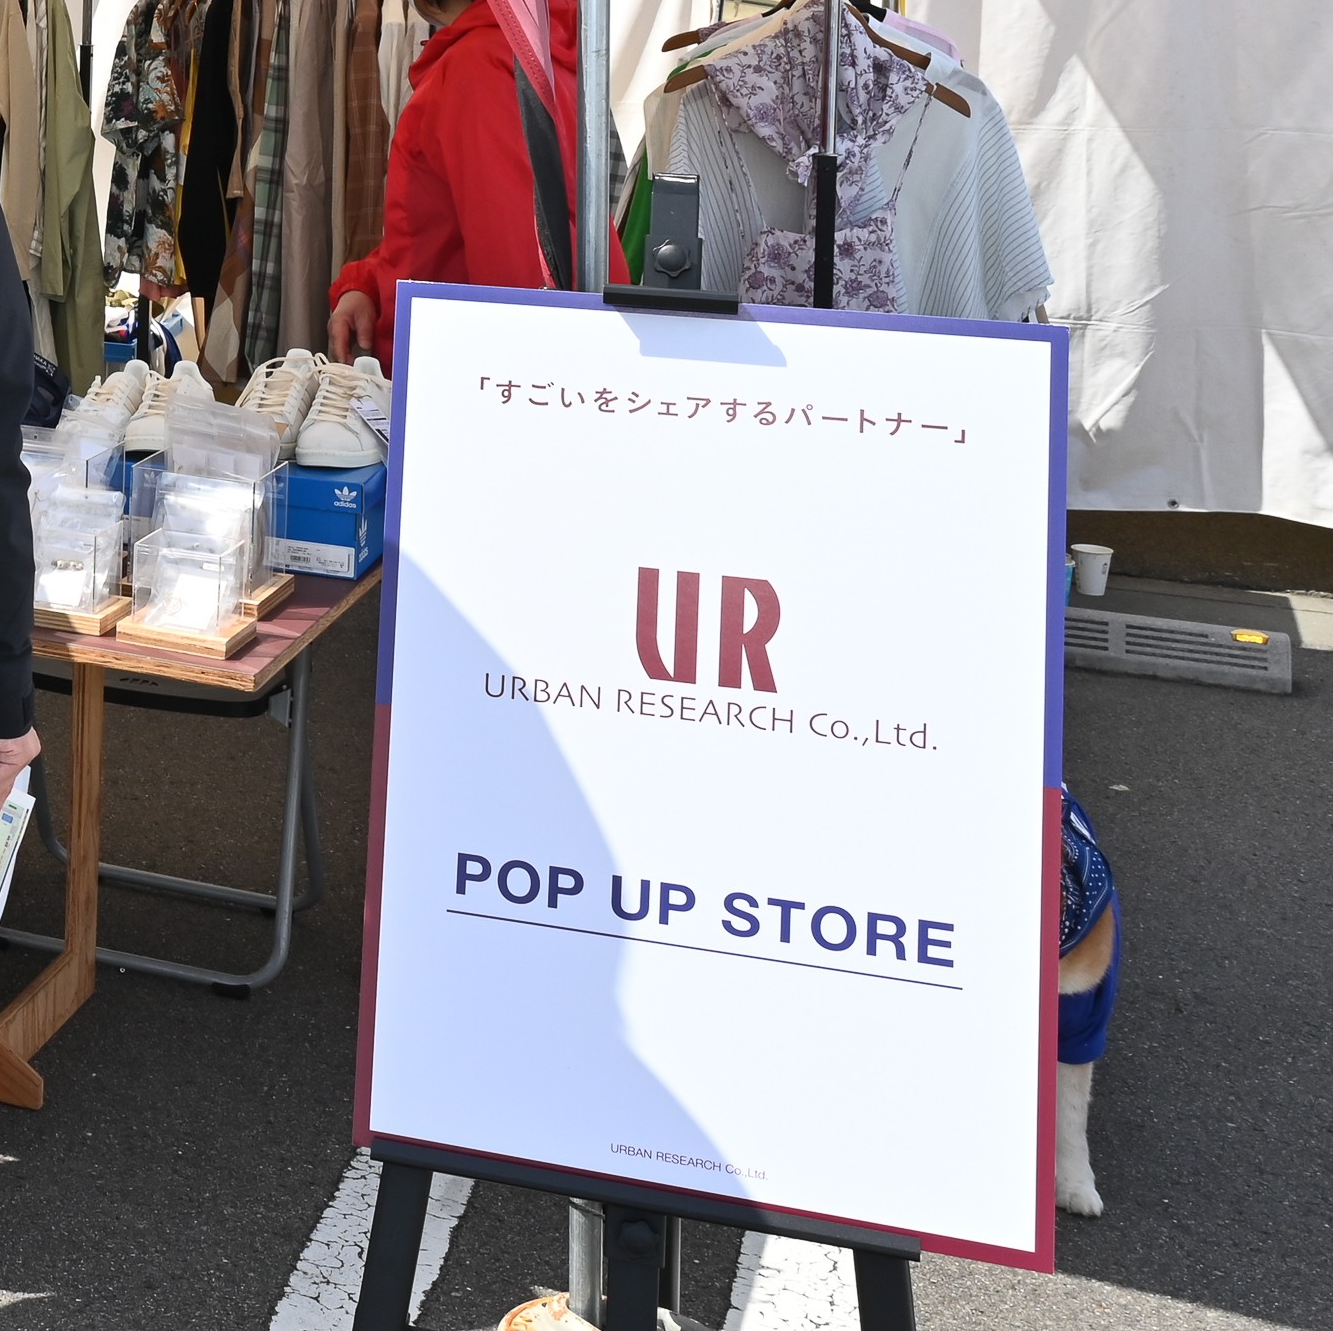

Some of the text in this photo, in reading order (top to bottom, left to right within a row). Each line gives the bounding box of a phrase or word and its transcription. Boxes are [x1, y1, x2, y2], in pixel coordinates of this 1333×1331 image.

[479, 375, 968, 445] 「すごいをシェアするパートナー」
[333, 501, 357, 509] adidas
[635, 566, 781, 694] UR
[484, 672, 940, 751] URBAN RESEARCH Co.,Ltd.
[455, 851, 956, 969] POP UP STORE
[610, 1142, 653, 1160] URBAN
[655, 1150, 722, 1172] RESEARCH
